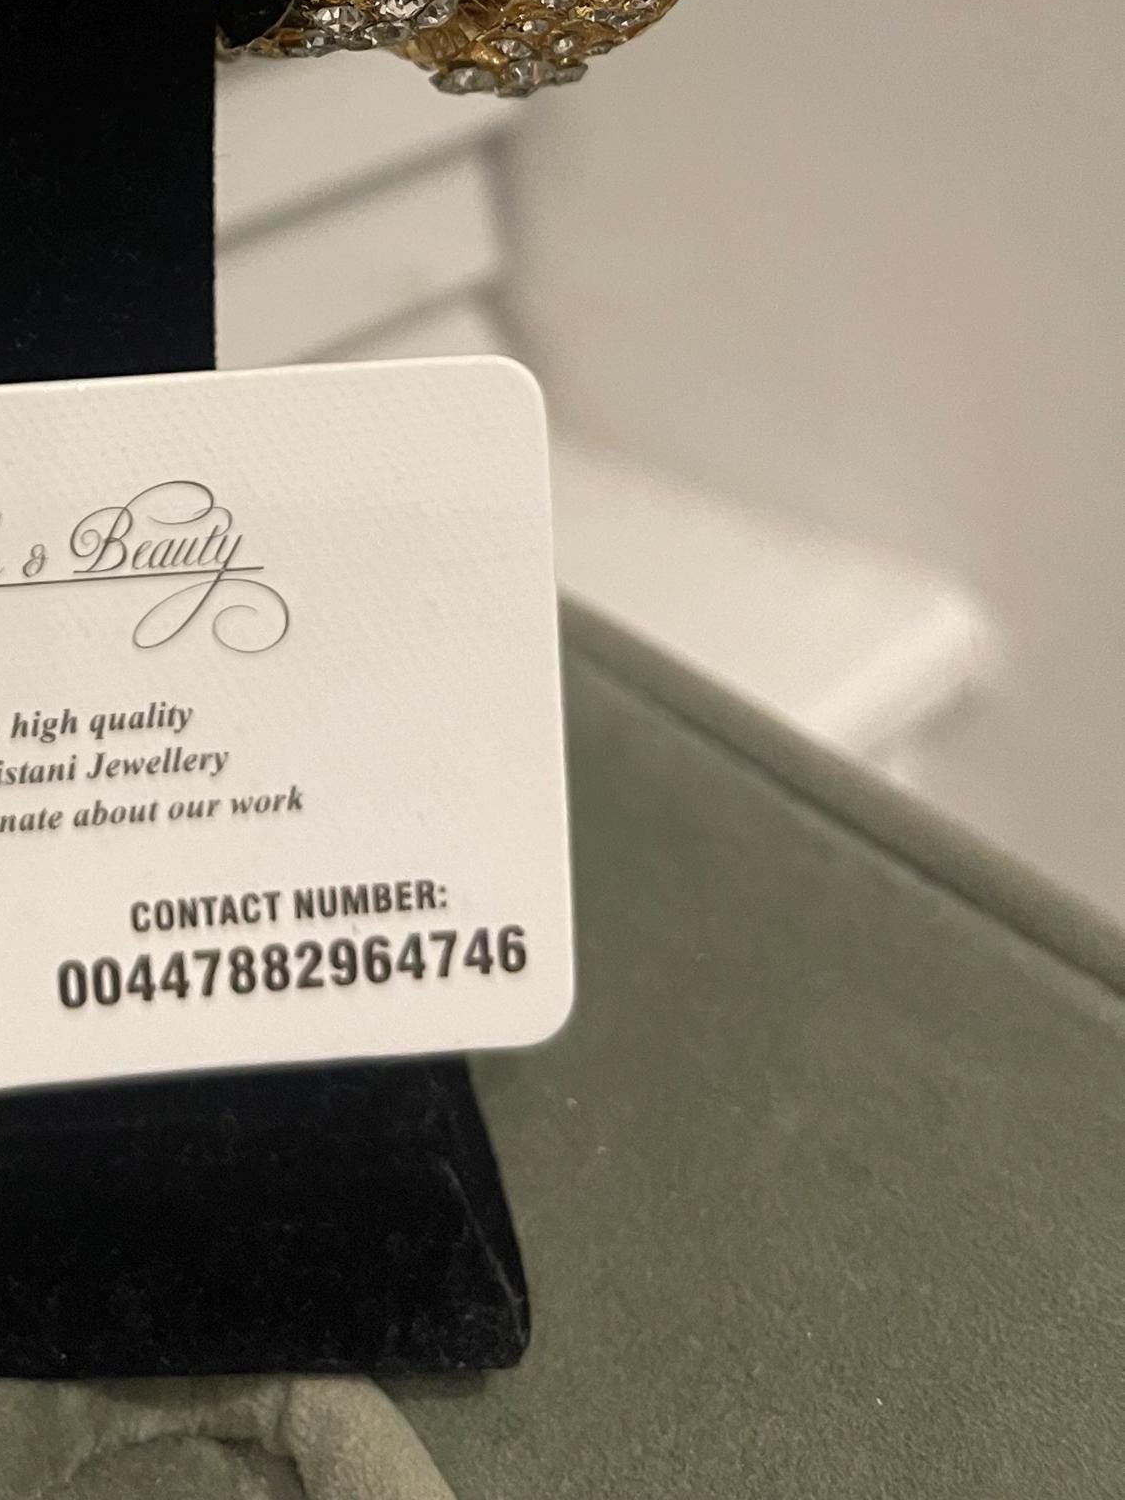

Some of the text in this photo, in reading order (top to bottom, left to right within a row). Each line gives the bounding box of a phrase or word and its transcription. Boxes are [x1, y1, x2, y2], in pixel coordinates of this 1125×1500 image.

[22, 544, 47, 579] &
[70, 480, 289, 653] Beauty
[11, 708, 78, 744] high
[89, 703, 194, 736] quality
[86, 747, 230, 781] Jewellery
[73, 800, 159, 829] about
[168, 798, 221, 821] our
[231, 786, 305, 815] work
[130, 878, 448, 933] CONTACT NUMBER:
[57, 924, 527, 1008] 00447882964746
